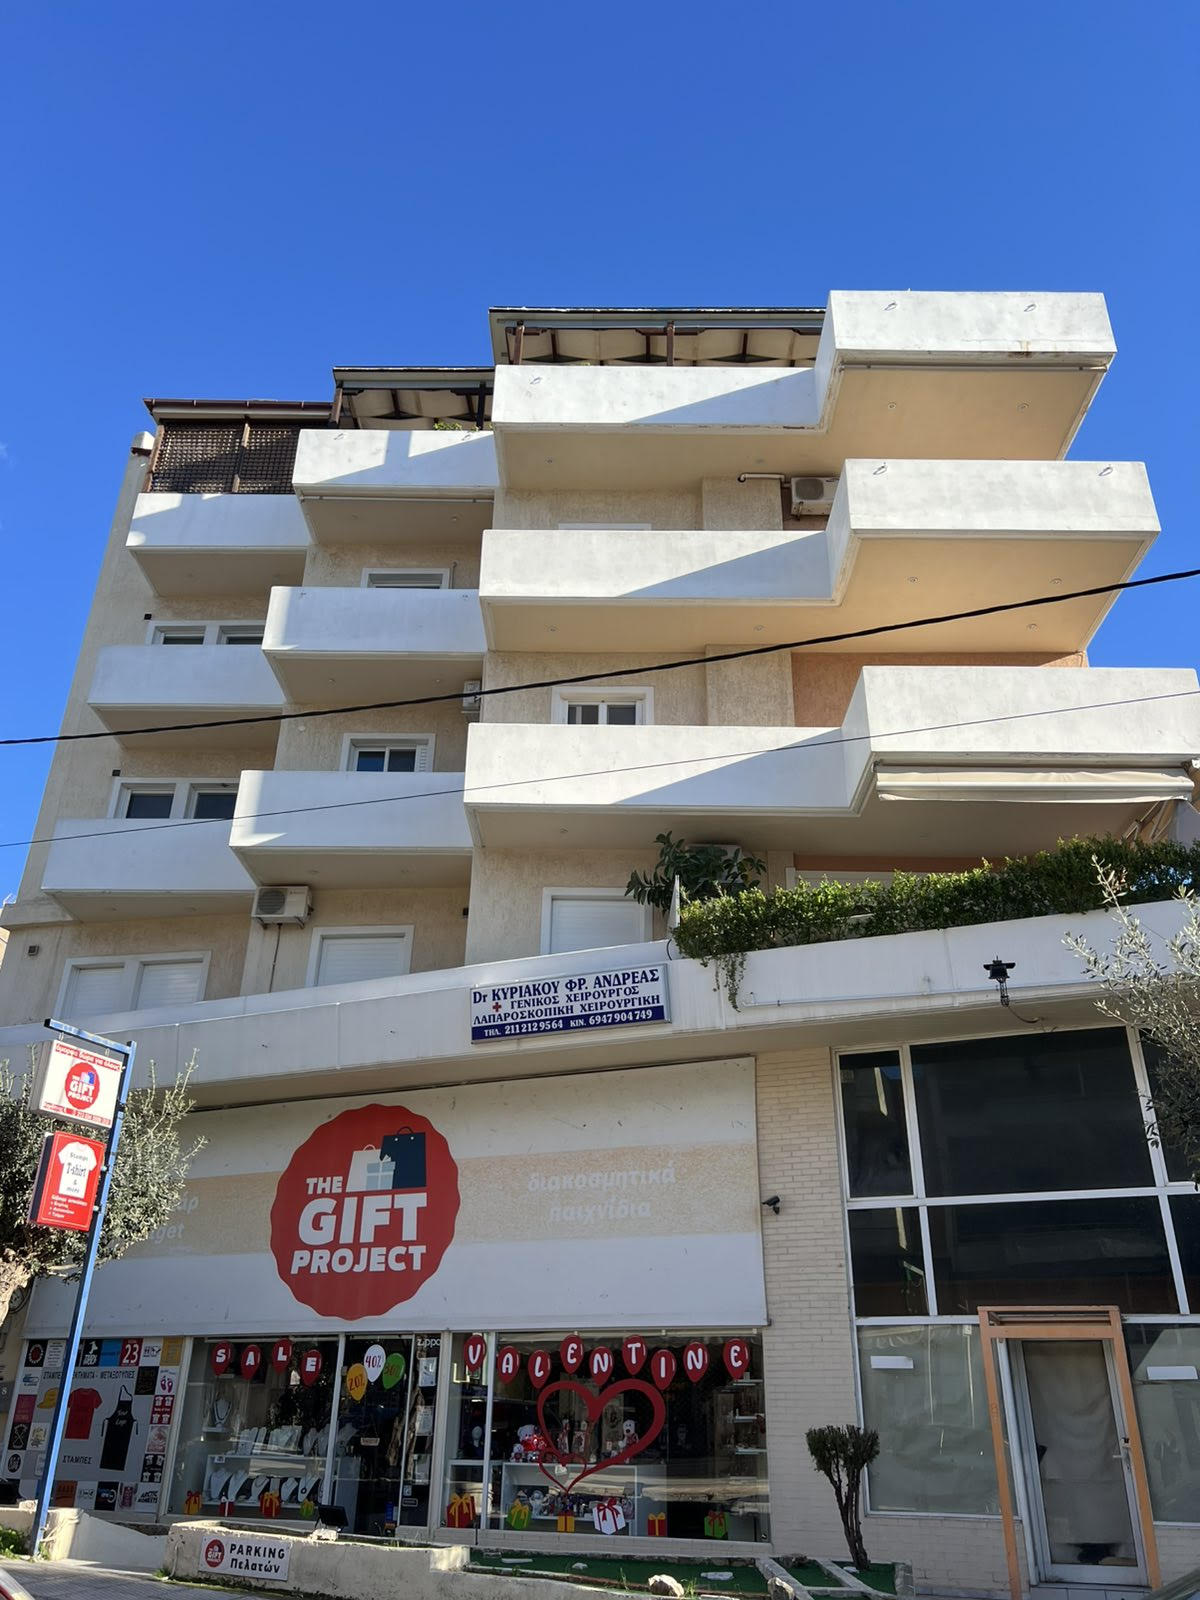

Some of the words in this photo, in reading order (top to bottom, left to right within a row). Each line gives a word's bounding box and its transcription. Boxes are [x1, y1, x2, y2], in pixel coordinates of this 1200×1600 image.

[473, 991, 488, 1004] Dr
[492, 981, 560, 1002] ΚΥΡΙΑΚΟΥ
[565, 977, 588, 992] ΦΡ.
[593, 968, 660, 989] ΑΝΔΡΕΑΣ
[511, 994, 560, 1010] ΓΕΝΙΚΟΣ
[566, 986, 640, 1004] ΧΕΙΡΟΥΡΓΟΣ
[473, 1004, 574, 1025] ΛΑΠΑΡΟΣΚΟΠΙΚΗ
[580, 995, 660, 1013] ΧΕΙΡΟΥΡΓΙΚΗ
[589, 1010, 652, 1026] 6947904749
[70, 1080, 95, 1098] GIFT
[306, 1176, 343, 1195] THE
[298, 1192, 428, 1246] GIFT
[290, 1245, 427, 1275] PROJECT
[122, 1343, 140, 1364] 23
[365, 1355, 383, 1369] 40%
[468, 1342, 742, 1378] VALENTINE
[229, 1543, 285, 1560] PARKING
[230, 1558, 281, 1574] Πελατών
